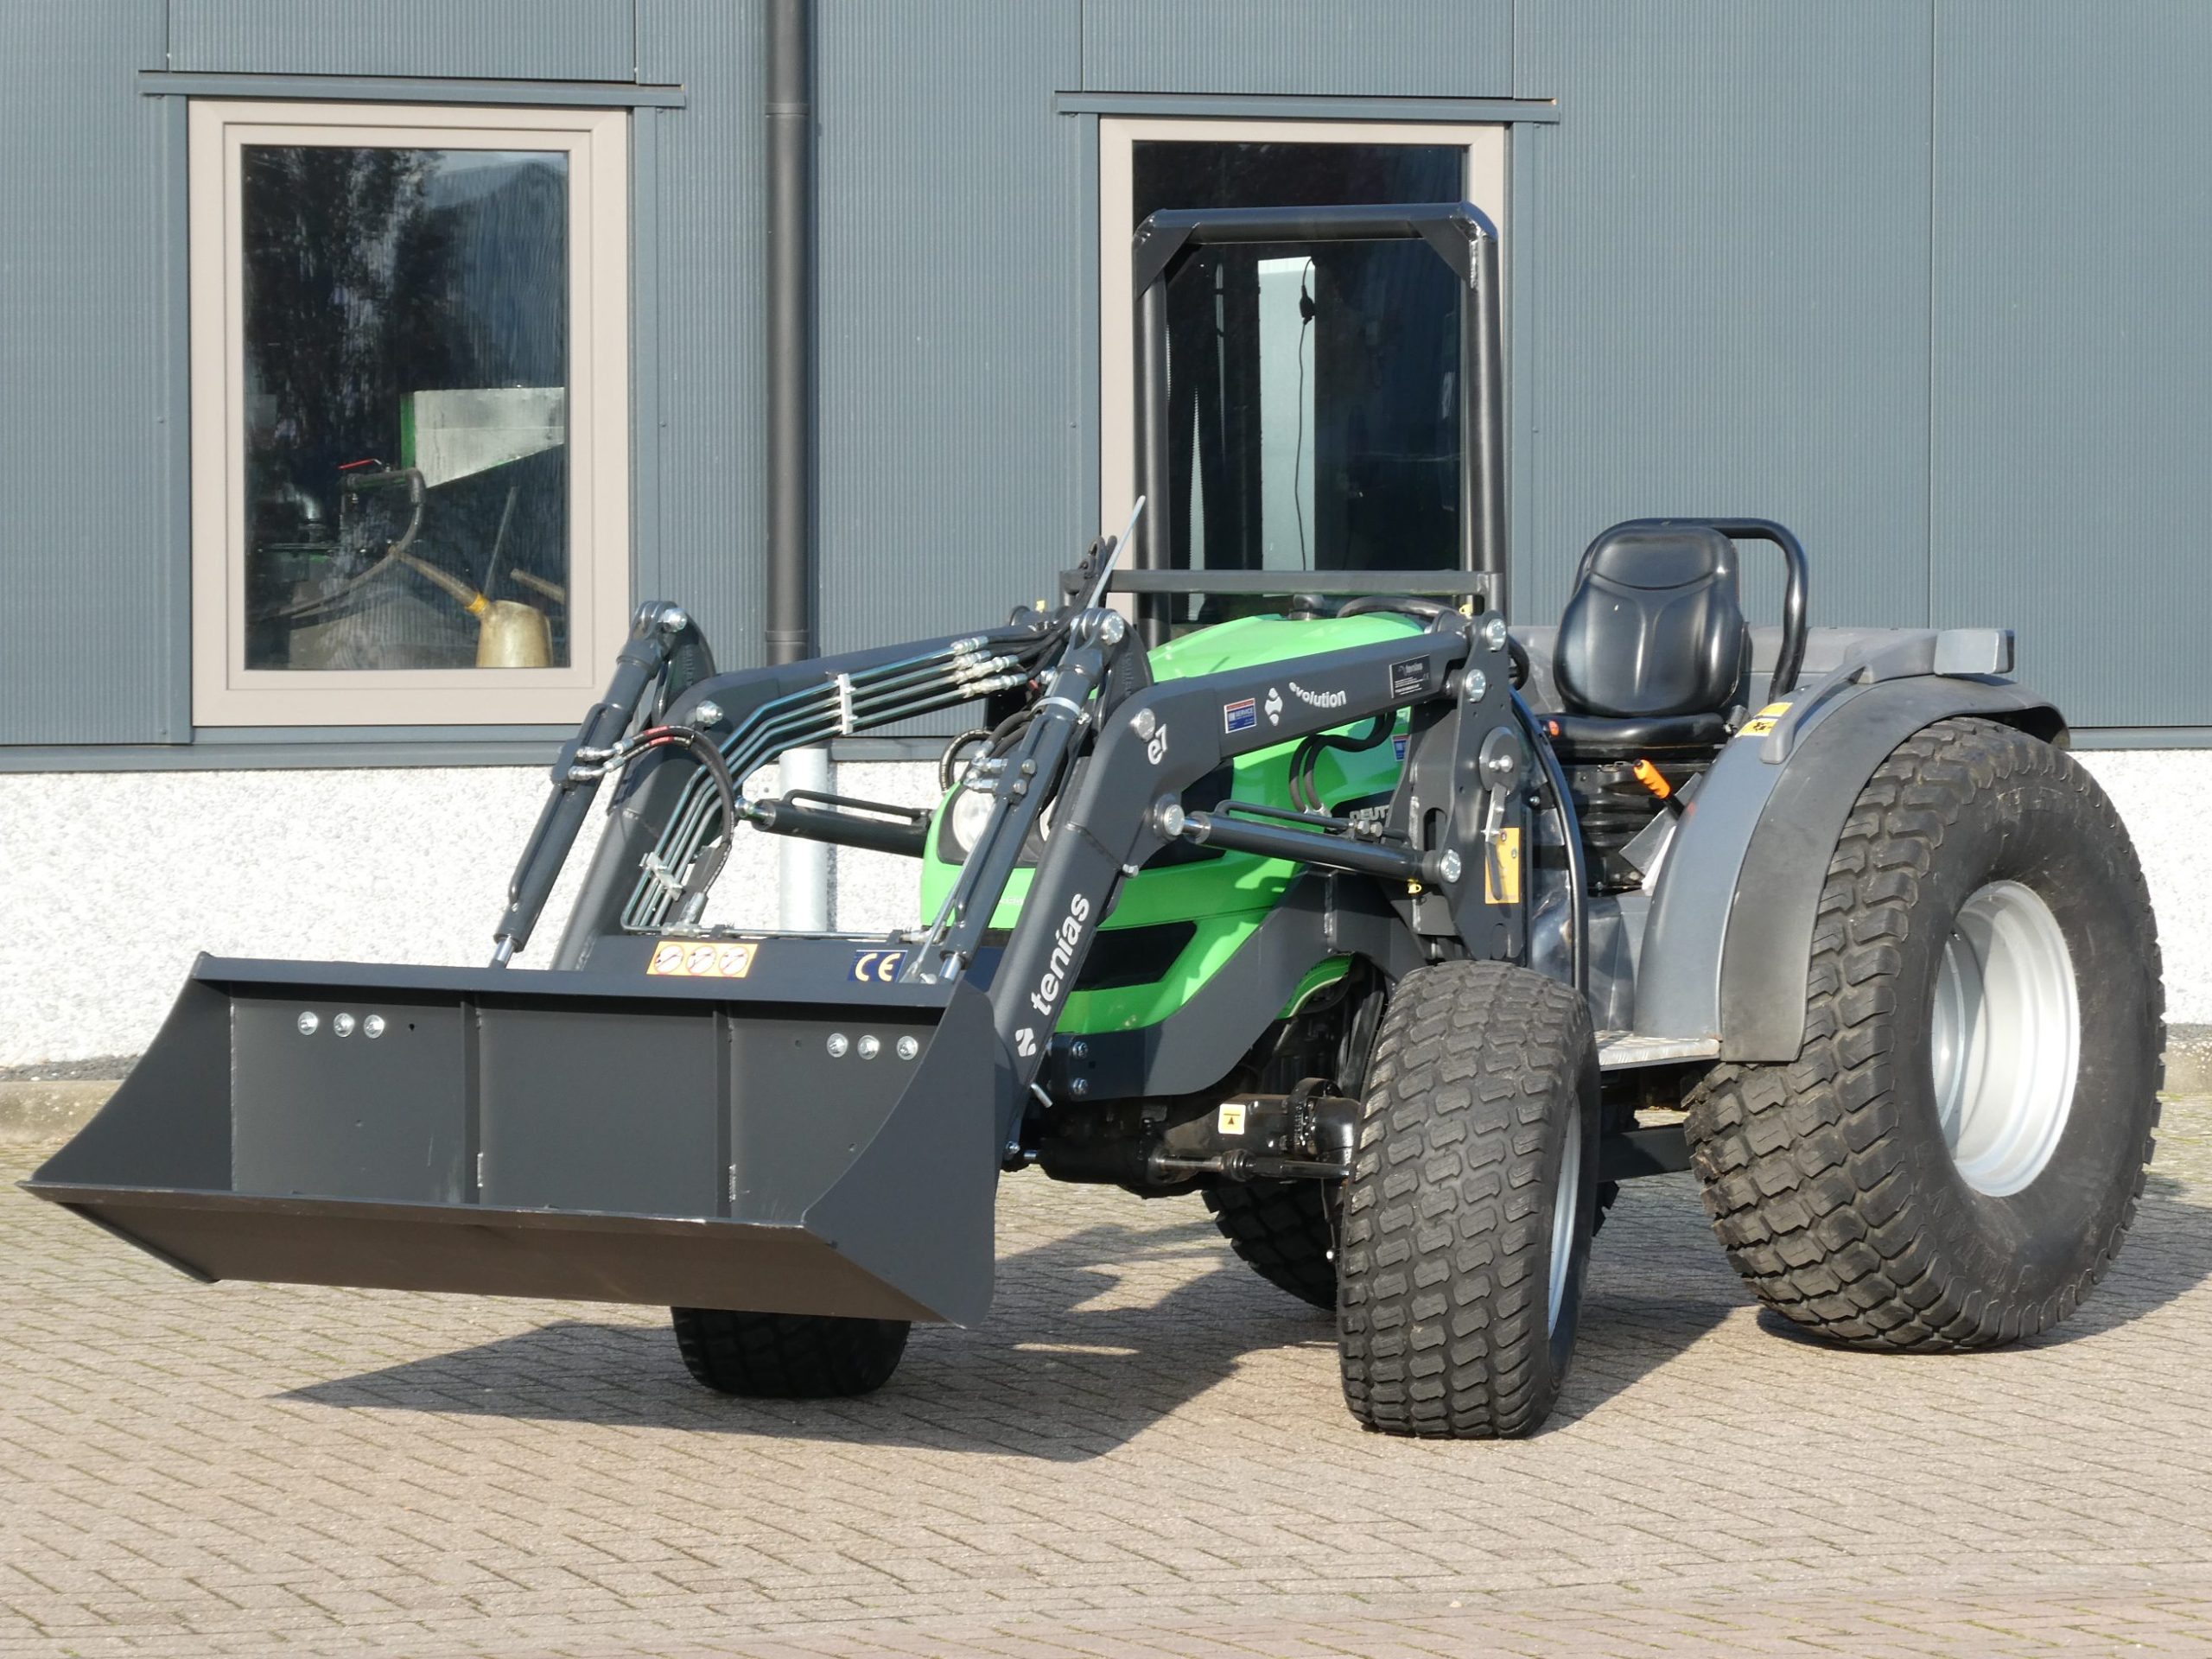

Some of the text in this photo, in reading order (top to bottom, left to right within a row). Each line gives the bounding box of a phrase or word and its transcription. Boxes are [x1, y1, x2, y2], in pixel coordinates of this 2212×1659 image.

[1288, 682, 1347, 709] evolution
[1147, 723, 1166, 765] e7
[1349, 804, 1390, 821] DEUT
[855, 952, 901, 982] CE
[1030, 893, 1090, 1016] tenias
